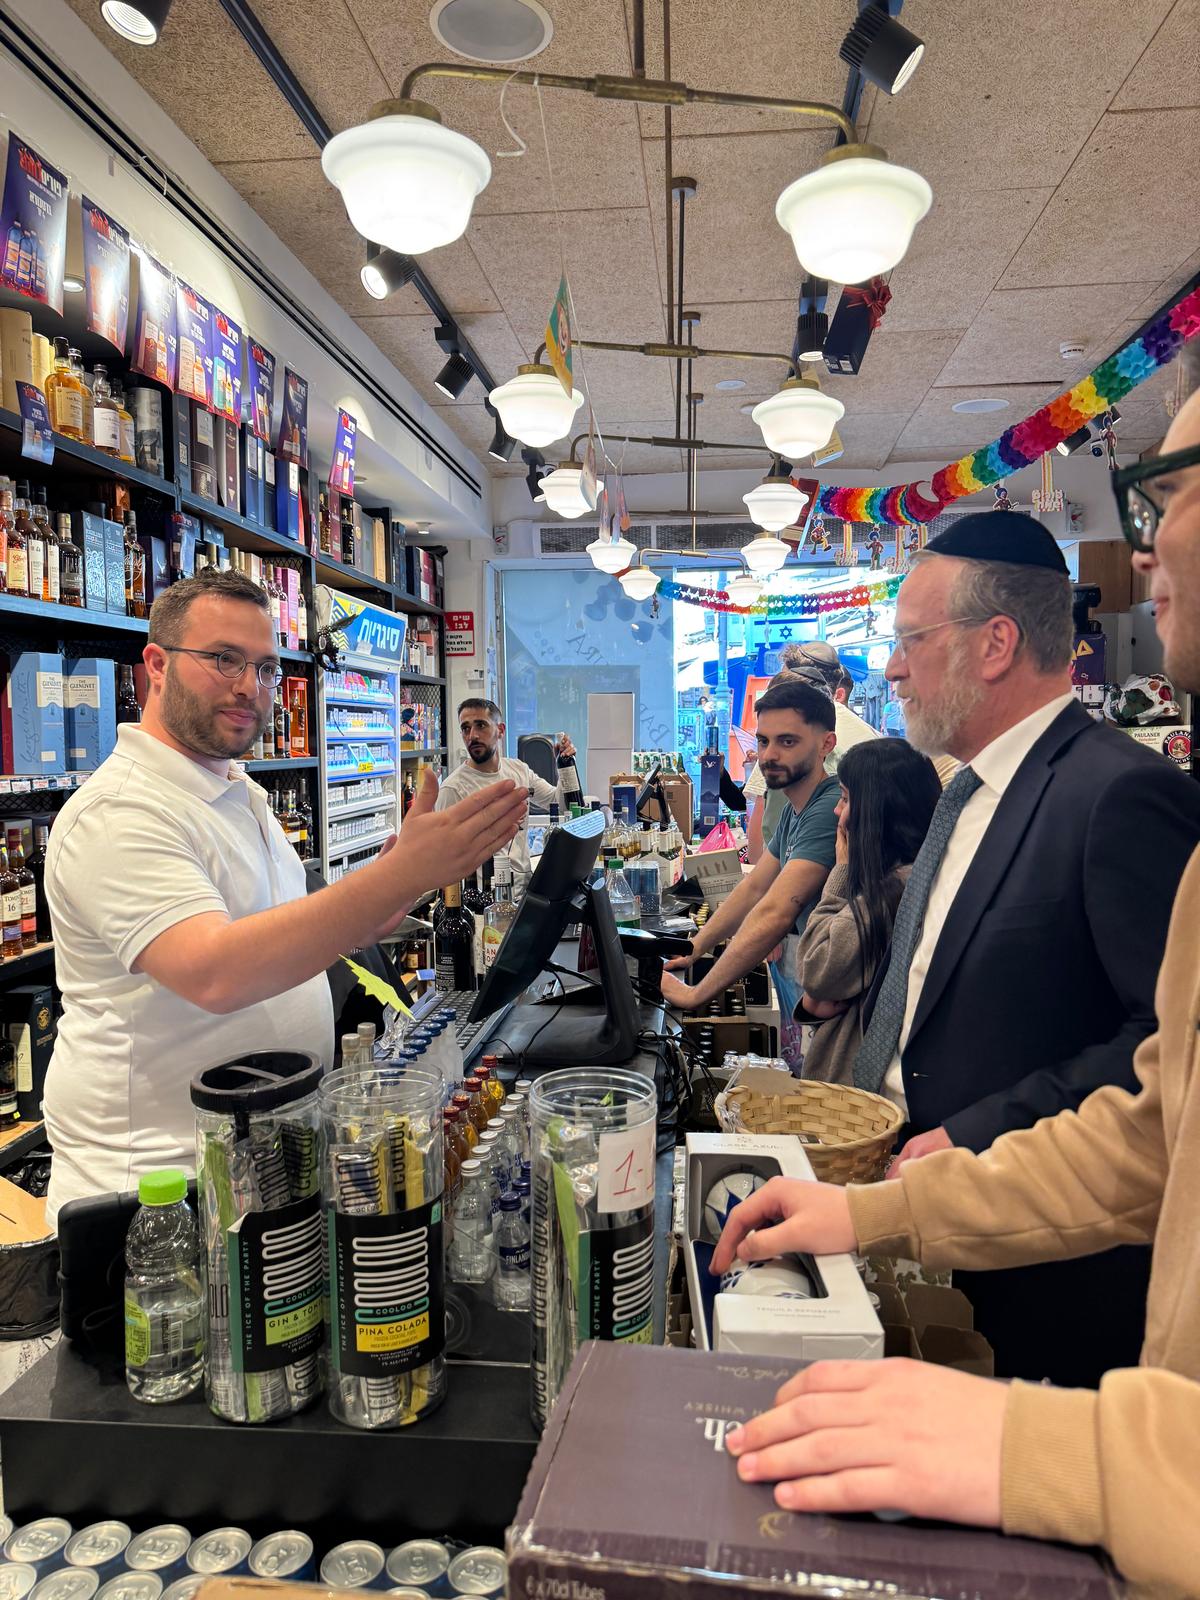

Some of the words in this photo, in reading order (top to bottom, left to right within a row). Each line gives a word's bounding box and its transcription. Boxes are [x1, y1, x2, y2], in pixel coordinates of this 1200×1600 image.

[356, 618, 400, 652] סיגריות
[8, 903, 16, 912] 16
[245, 1297, 251, 1310] OF
[340, 1296, 345, 1310] OF
[375, 1303, 414, 1316] COOLOO
[268, 1316, 286, 1328] GIN
[293, 1314, 299, 1322] &
[359, 1327, 384, 1336] PINA
[388, 1317, 427, 1335] COLADA
[594, 1316, 600, 1330] OF
[684, 1401, 746, 1415] WHISKY
